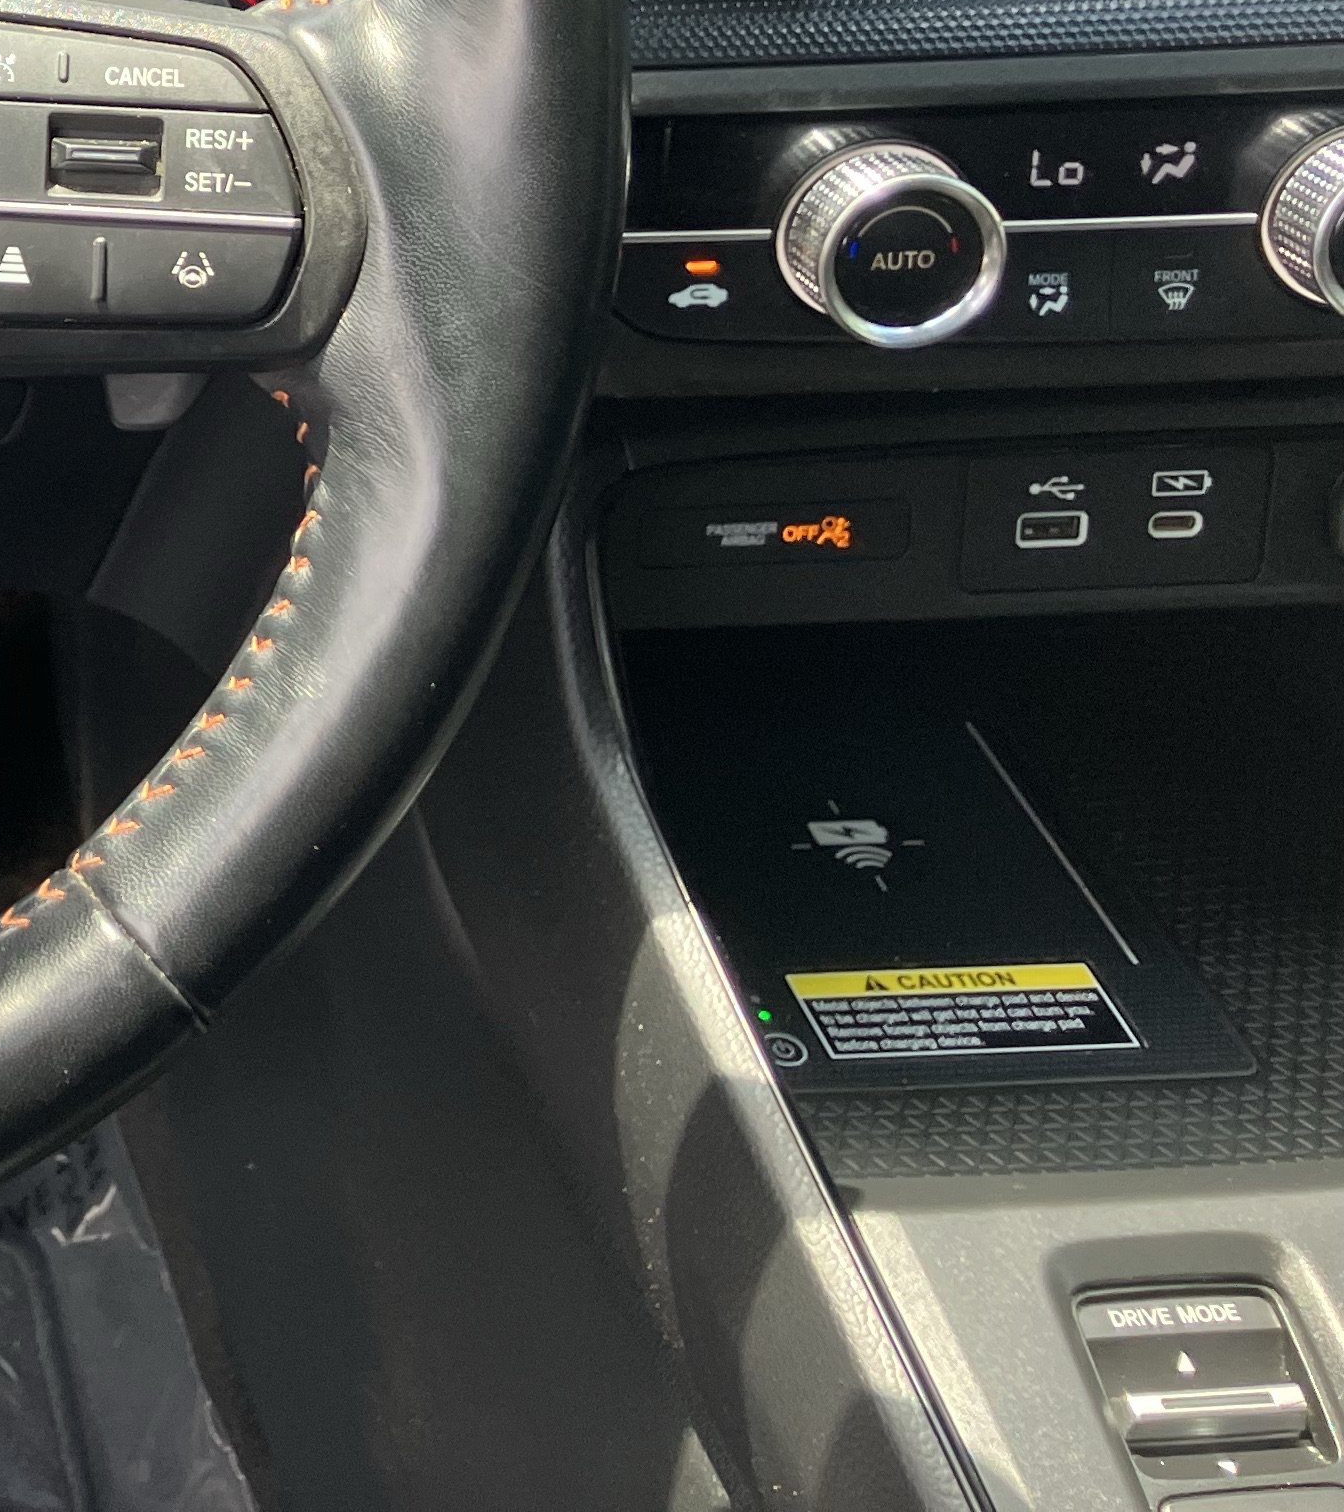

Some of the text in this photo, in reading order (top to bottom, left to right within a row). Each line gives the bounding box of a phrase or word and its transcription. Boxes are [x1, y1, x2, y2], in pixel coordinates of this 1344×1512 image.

[104, 65, 185, 89] CANCEL
[185, 128, 254, 152] RES/+
[870, 249, 937, 273] AUTO
[1028, 273, 1069, 288] MODE
[1153, 269, 1200, 285] FRONT
[782, 524, 821, 543] OFF
[896, 972, 1017, 990] CAUTION
[1106, 1302, 1242, 1329] DRIVE MODE
